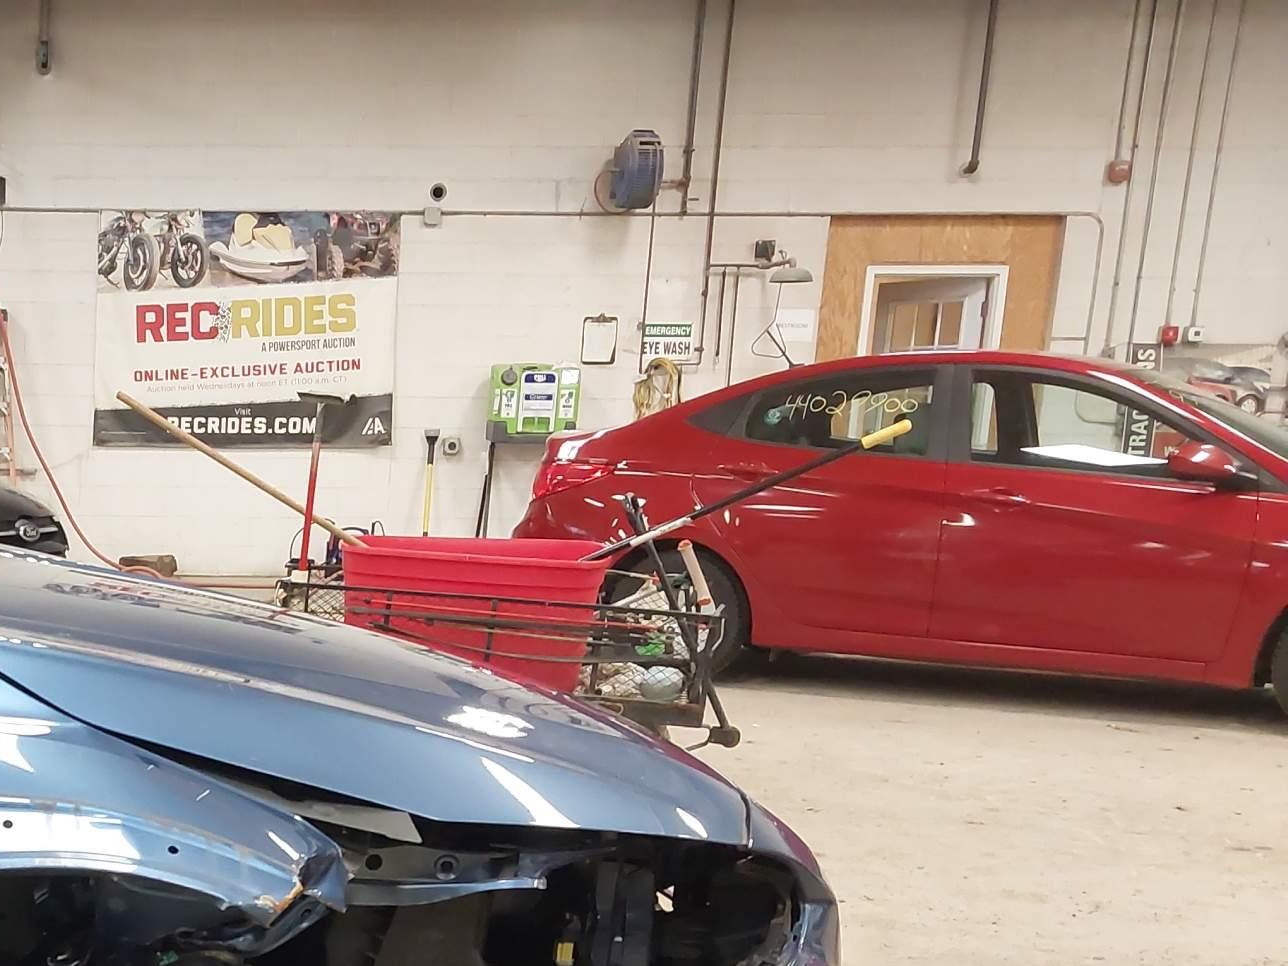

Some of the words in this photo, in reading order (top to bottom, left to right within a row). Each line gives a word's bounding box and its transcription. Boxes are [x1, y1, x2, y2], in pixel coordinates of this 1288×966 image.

[135, 301, 220, 343] REC
[231, 293, 357, 339] RIDES
[645, 325, 691, 336] EMERGENCY
[261, 341, 267, 352] A
[268, 339, 322, 353] POWERSPORT
[322, 336, 356, 350] AUCTION
[642, 341, 661, 355] EYE
[663, 341, 691, 355] WASH
[133, 362, 289, 382] ONLINE-EXCLUSIVE
[293, 358, 361, 375] AUCTION
[234, 406, 252, 416] Visit
